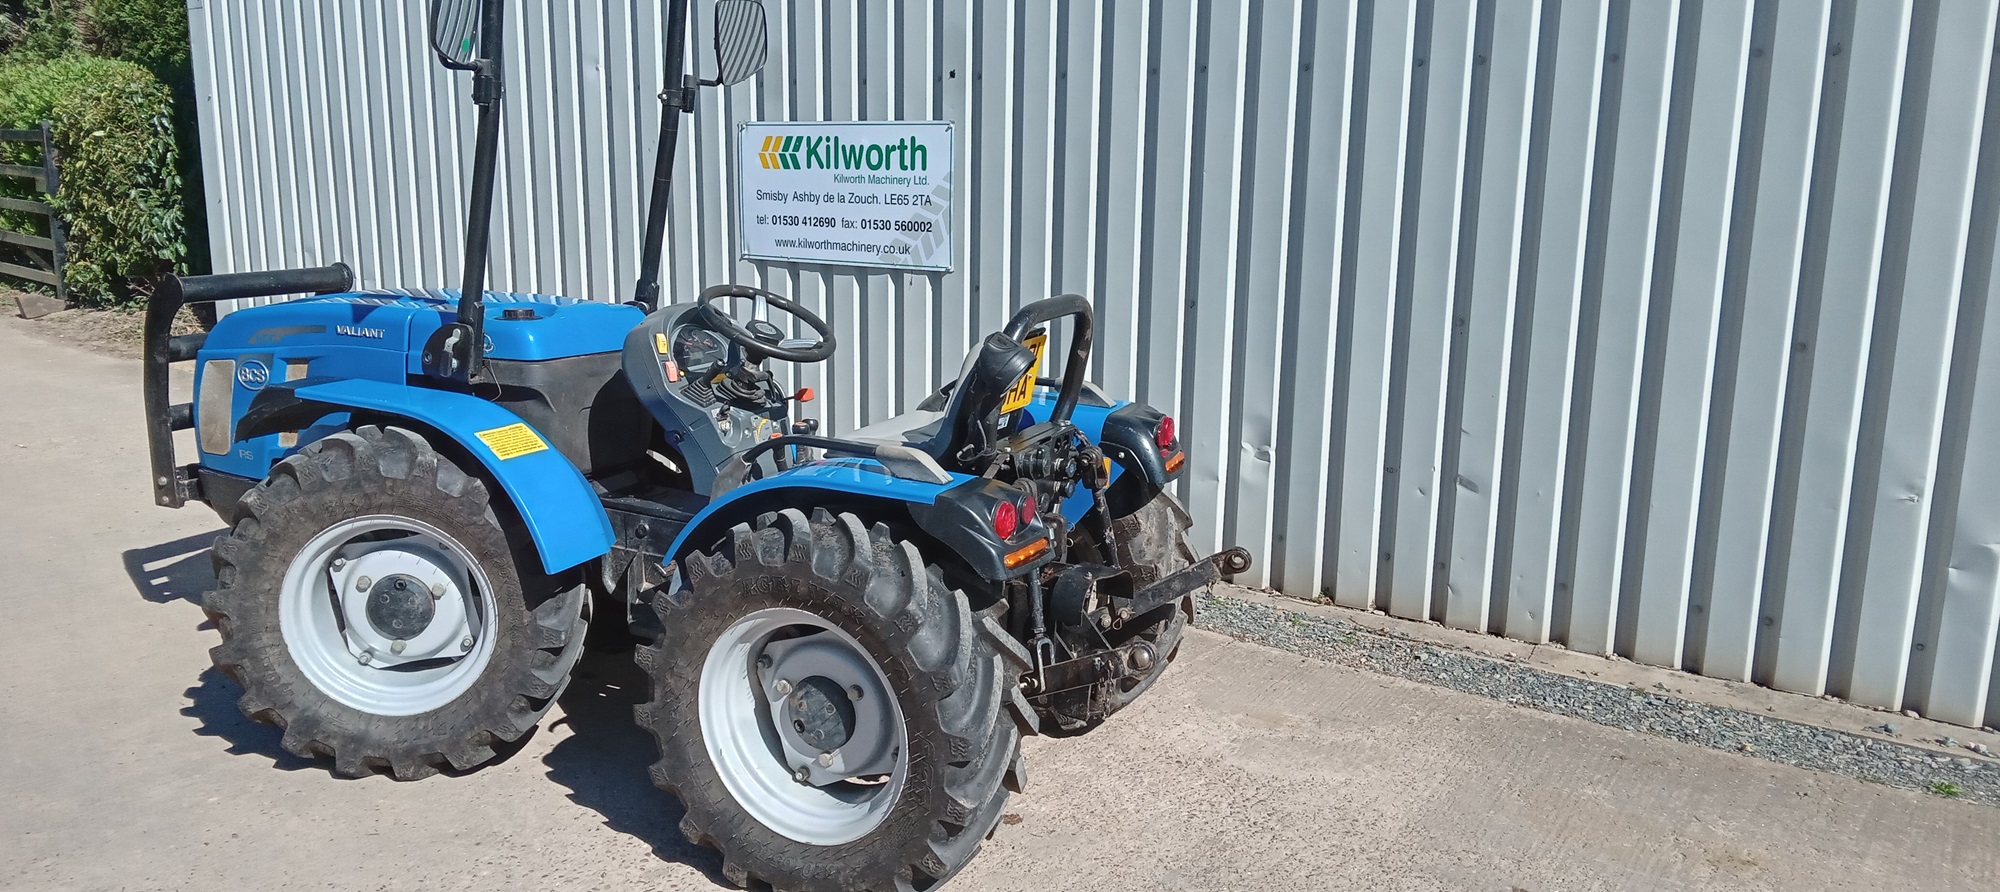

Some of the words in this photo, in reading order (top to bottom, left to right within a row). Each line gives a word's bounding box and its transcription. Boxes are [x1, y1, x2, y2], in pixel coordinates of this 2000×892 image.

[806, 136, 927, 171] Kilworth
[833, 174, 866, 184] Kilworth
[868, 174, 911, 187] Machinery
[913, 175, 929, 185] Ltd.
[756, 189, 788, 204] Smisby
[792, 191, 820, 205] Ashby
[823, 192, 835, 203] de
[837, 192, 846, 204] la
[848, 193, 881, 204] Zouch.
[884, 193, 909, 206] LE65
[912, 194, 932, 206] 2TA
[756, 214, 769, 225] tel:
[771, 215, 799, 226] 01530
[801, 216, 836, 228] 412690
[841, 217, 858, 229] fax:
[860, 218, 891, 230] 01530
[894, 220, 932, 233] 560002
[774, 238, 911, 256] www.kilworthmachinery.co.uk
[335, 324, 385, 339] VALIANT
[241, 366, 265, 384] BCS
[1003, 374, 1029, 406] HA
